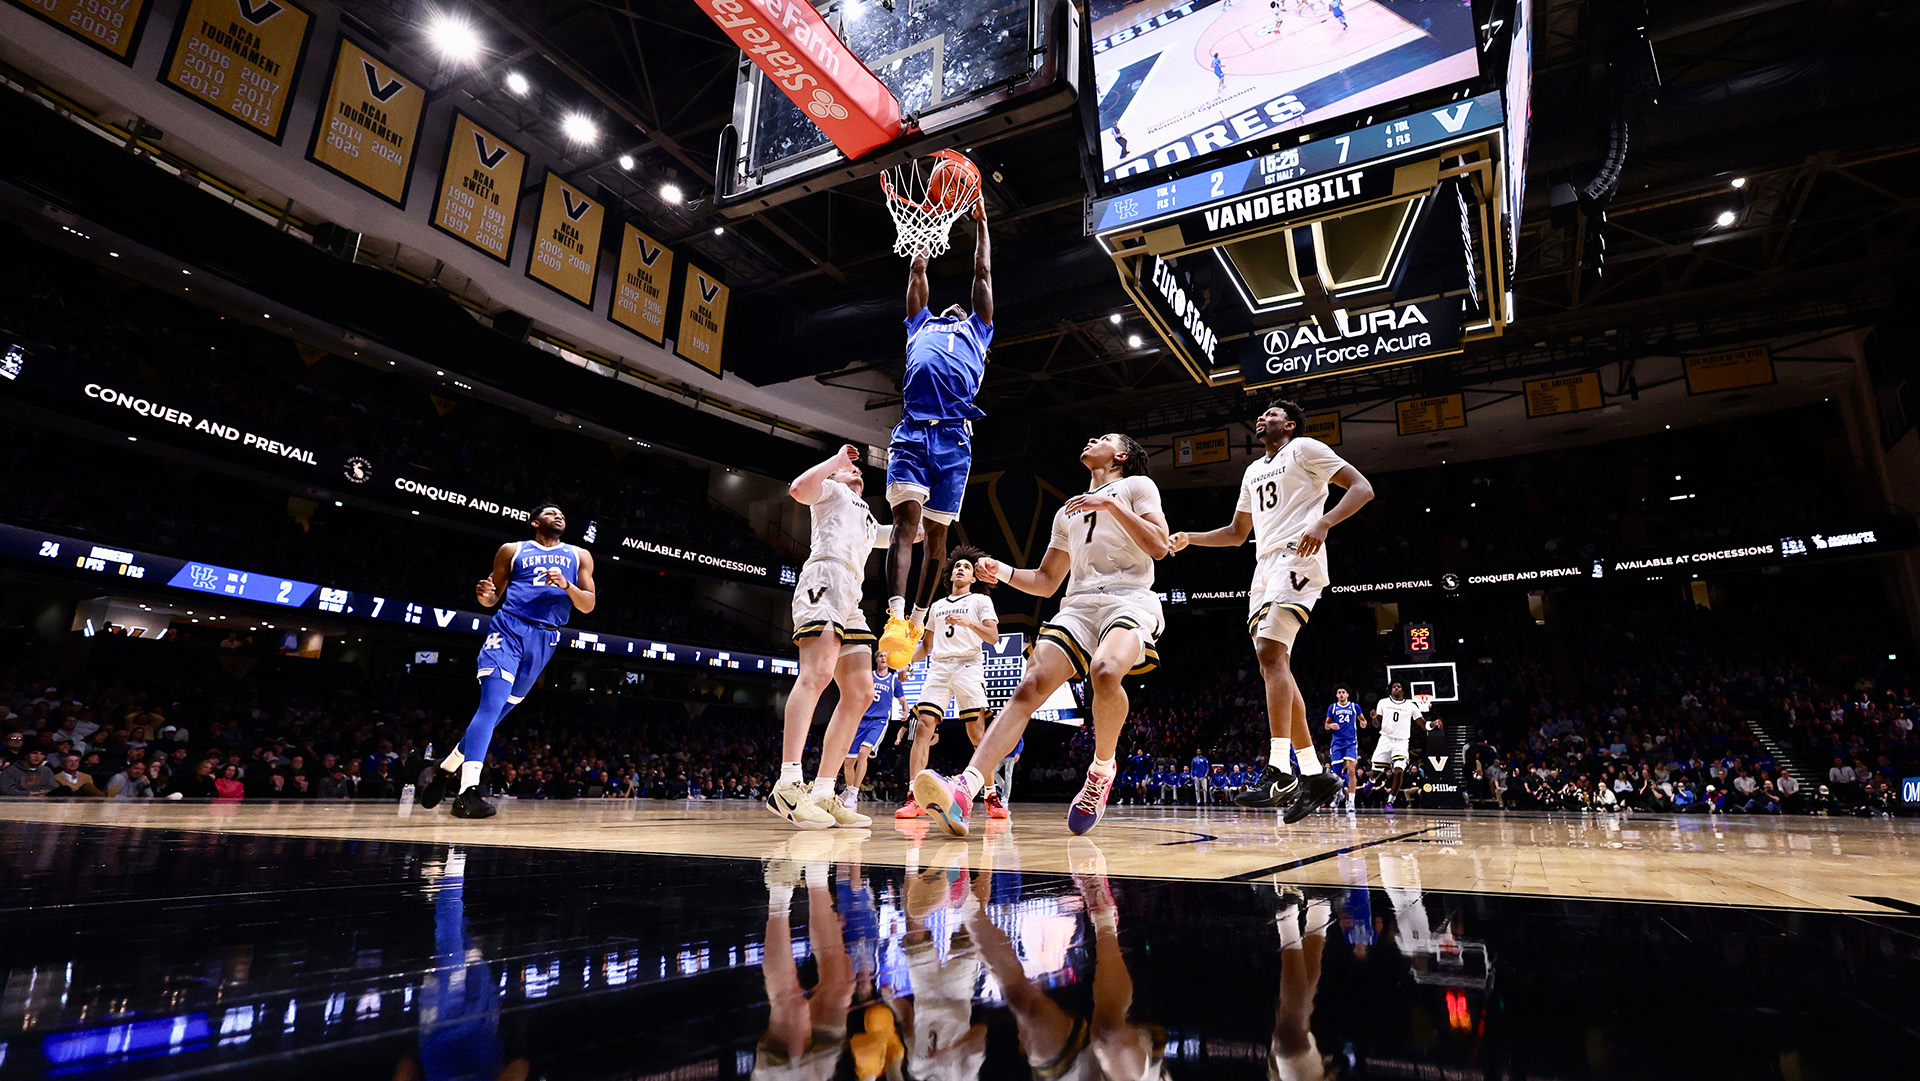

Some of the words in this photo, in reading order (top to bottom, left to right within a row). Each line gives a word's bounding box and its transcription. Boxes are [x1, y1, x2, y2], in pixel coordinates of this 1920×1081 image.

[69, 10, 119, 45] 2003
[228, 22, 261, 51] NCAA
[201, 20, 281, 77] TOURNAMENT
[188, 37, 232, 69] 2006
[241, 67, 280, 95] 2007
[184, 53, 225, 84] 2010
[237, 83, 272, 111] 2011
[179, 69, 220, 100] 2012
[231, 98, 270, 127] 2013
[339, 101, 404, 149] TOURNAMENT
[361, 101, 387, 126] NCAA
[1431, 101, 1474, 133] V
[1385, 125, 1391, 135] 4
[1394, 120, 1410, 133] TOL
[1396, 133, 1411, 147] FLS
[326, 131, 360, 158] 2025
[331, 117, 363, 143] 2014
[371, 140, 403, 166] 2024
[472, 129, 510, 170] V
[1335, 135, 1351, 164] 7
[462, 176, 490, 199] SWEET
[472, 169, 494, 190] NCAA
[1210, 171, 1224, 198] 2
[1277, 168, 1295, 184] HALF
[1156, 187, 1169, 198] TOL
[1171, 185, 1176, 194] 4
[1204, 171, 1364, 232] VANDERBILT
[448, 184, 475, 209] 1990
[482, 205, 506, 227] 1991
[560, 186, 593, 223] V
[1157, 199, 1169, 210] FLS
[445, 198, 472, 222] 1994
[479, 218, 504, 239] 1995
[561, 221, 579, 241] NCAA
[443, 212, 470, 235] 1997
[475, 230, 503, 253] 2004
[553, 228, 576, 250] SWEET
[537, 250, 562, 272] 2009
[540, 238, 564, 259] 2005
[568, 254, 591, 275] 2008
[635, 233, 663, 268] V
[627, 273, 642, 290] ELITE
[643, 282, 660, 299] EIGHT
[637, 267, 652, 284] NCAA
[620, 284, 640, 302] 1992
[697, 273, 721, 304] V
[618, 296, 637, 314] 2001
[642, 309, 661, 326] 2002
[689, 309, 704, 326] FINAL
[705, 319, 718, 334] FOUR
[698, 305, 711, 320] NCAA
[947, 333, 955, 353] 1
[1265, 353, 1312, 374] Gary
[1315, 343, 1370, 366] Force
[1374, 331, 1432, 356] Acura
[84, 383, 193, 428] CONQUER
[195, 418, 240, 441] AND
[243, 432, 317, 466] PREVAIL
[1251, 465, 1286, 485] VANDERBILT
[394, 477, 467, 506] CONQUER
[469, 497, 500, 514] AND
[1256, 480, 1278, 512] 13
[1083, 510, 1097, 545] 7
[39, 540, 60, 558] 24
[622, 537, 681, 558] AVAILABLE
[682, 551, 697, 561] AT
[698, 554, 767, 577] CONCESSIONS
[1615, 556, 1673, 571] AVAILABLE
[1675, 555, 1690, 564] AT
[1691, 544, 1774, 562] CONCESSIONS
[521, 555, 572, 570] KENTUCKY
[1331, 583, 1374, 593] CONQUER
[1374, 582, 1394, 590] AND
[1396, 579, 1433, 589] PREVAIL
[1468, 573, 1515, 584] CONQUER
[1516, 571, 1538, 580] AND
[1539, 567, 1582, 578] PREVAIL
[276, 581, 293, 603] 2
[806, 586, 828, 604] V
[1191, 591, 1234, 599] AVAILABLE
[1236, 590, 1247, 598] AT
[371, 597, 385, 618] 7
[433, 608, 457, 627] V
[935, 608, 969, 617] VANDERBILT
[1410, 627, 1430, 637] 15:25
[1410, 636, 1429, 650] 25
[1338, 714, 1350, 723] 24
[1393, 711, 1399, 722] 0
[1428, 756, 1449, 771] V
[1432, 783, 1458, 792] Hiller
